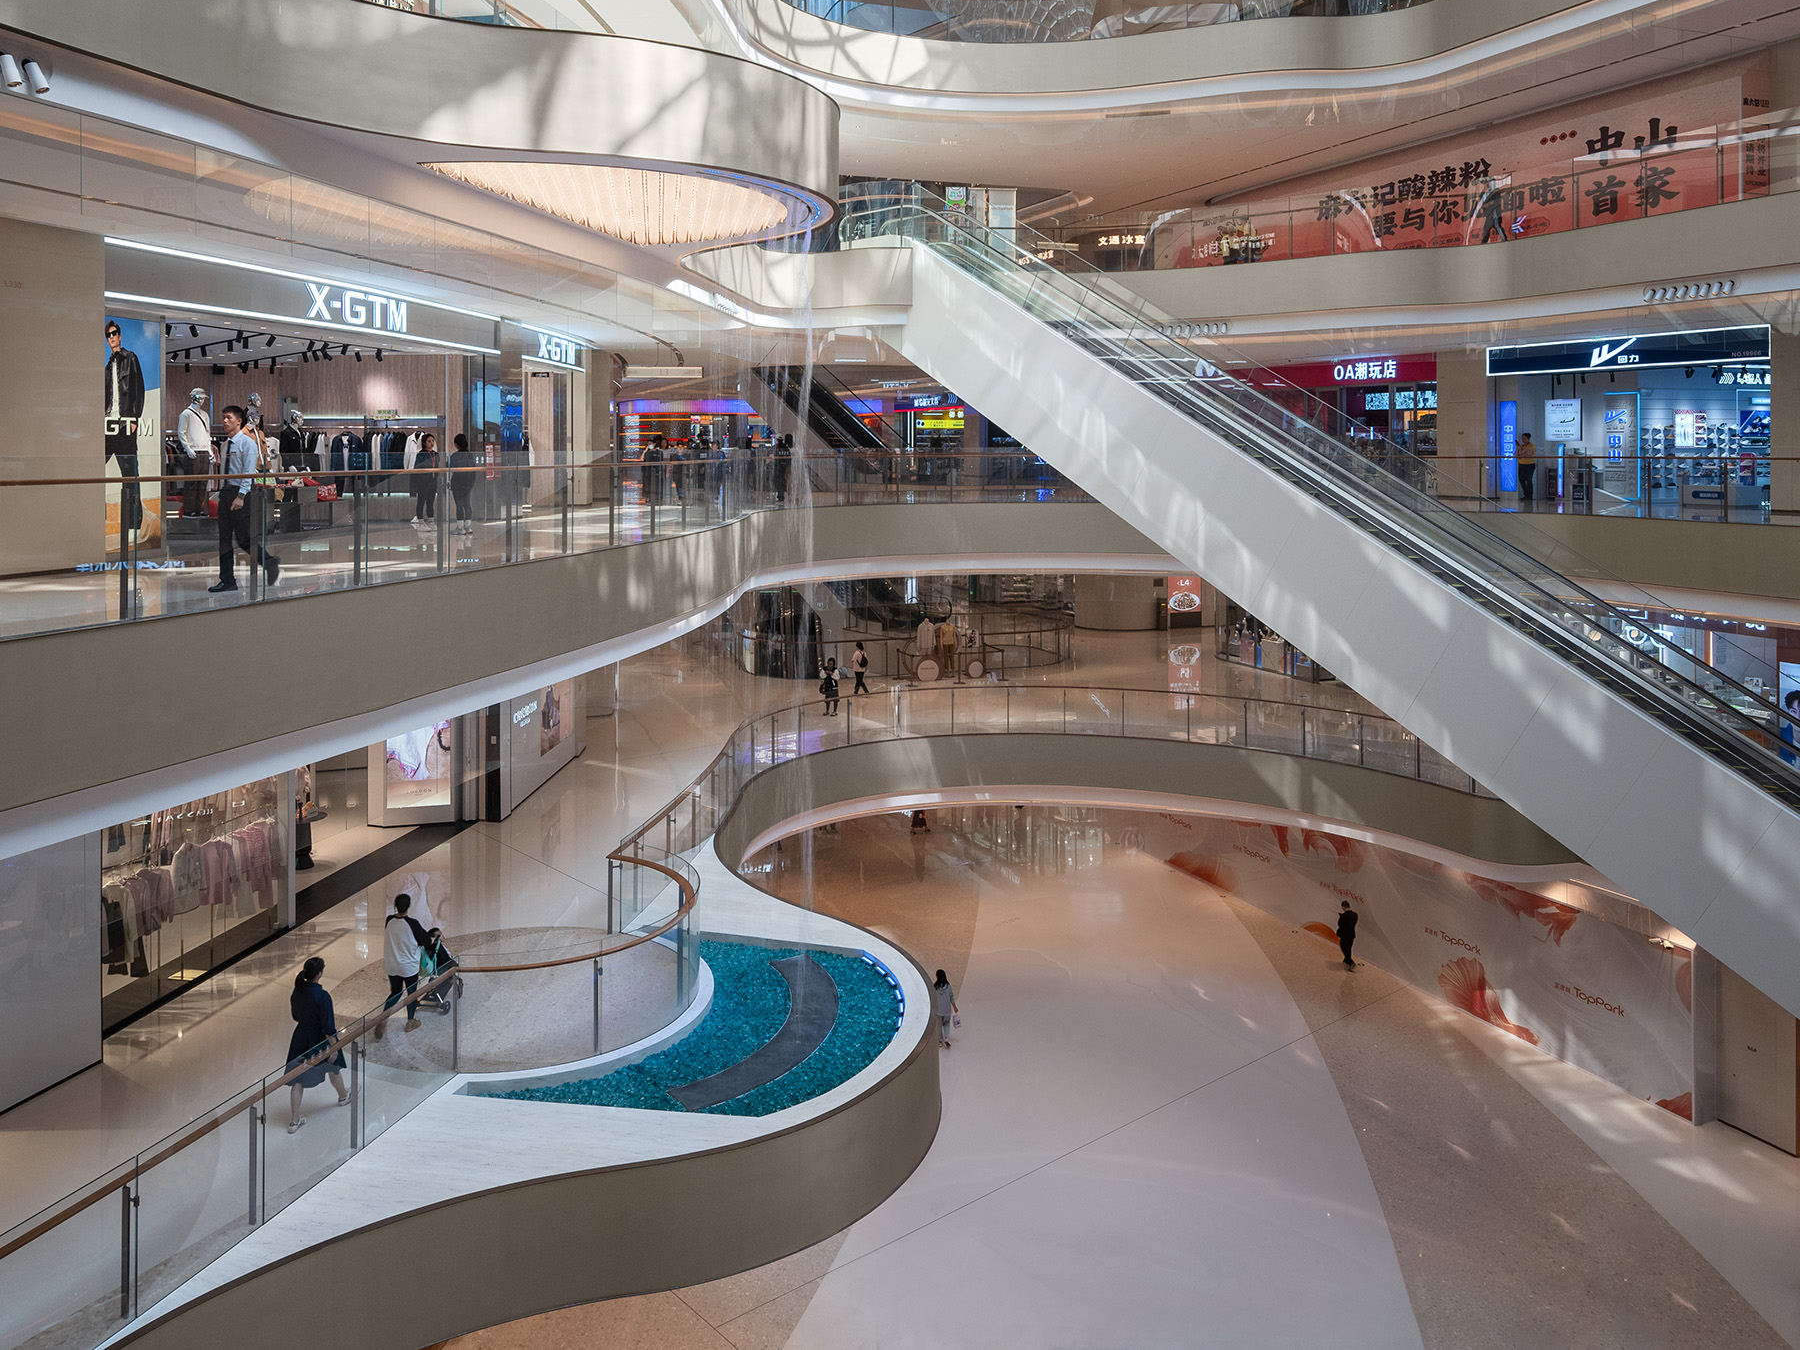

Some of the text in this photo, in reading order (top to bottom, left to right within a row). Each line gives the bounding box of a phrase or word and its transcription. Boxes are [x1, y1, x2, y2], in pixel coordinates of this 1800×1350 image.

[1585, 117, 1678, 167] 中山
[1757, 137, 1766, 176] 将开业
[1316, 158, 1492, 221] 麻六记酸辣粉
[1584, 166, 1681, 217] 首家
[304, 281, 408, 333] X-GTM
[537, 332, 576, 365] X-GTM
[1617, 354, 1640, 364] 回力
[1333, 359, 1397, 381] OA潮玩店
[1440, 930, 1482, 956] TopPark
[1573, 986, 1625, 1018] TopPark
